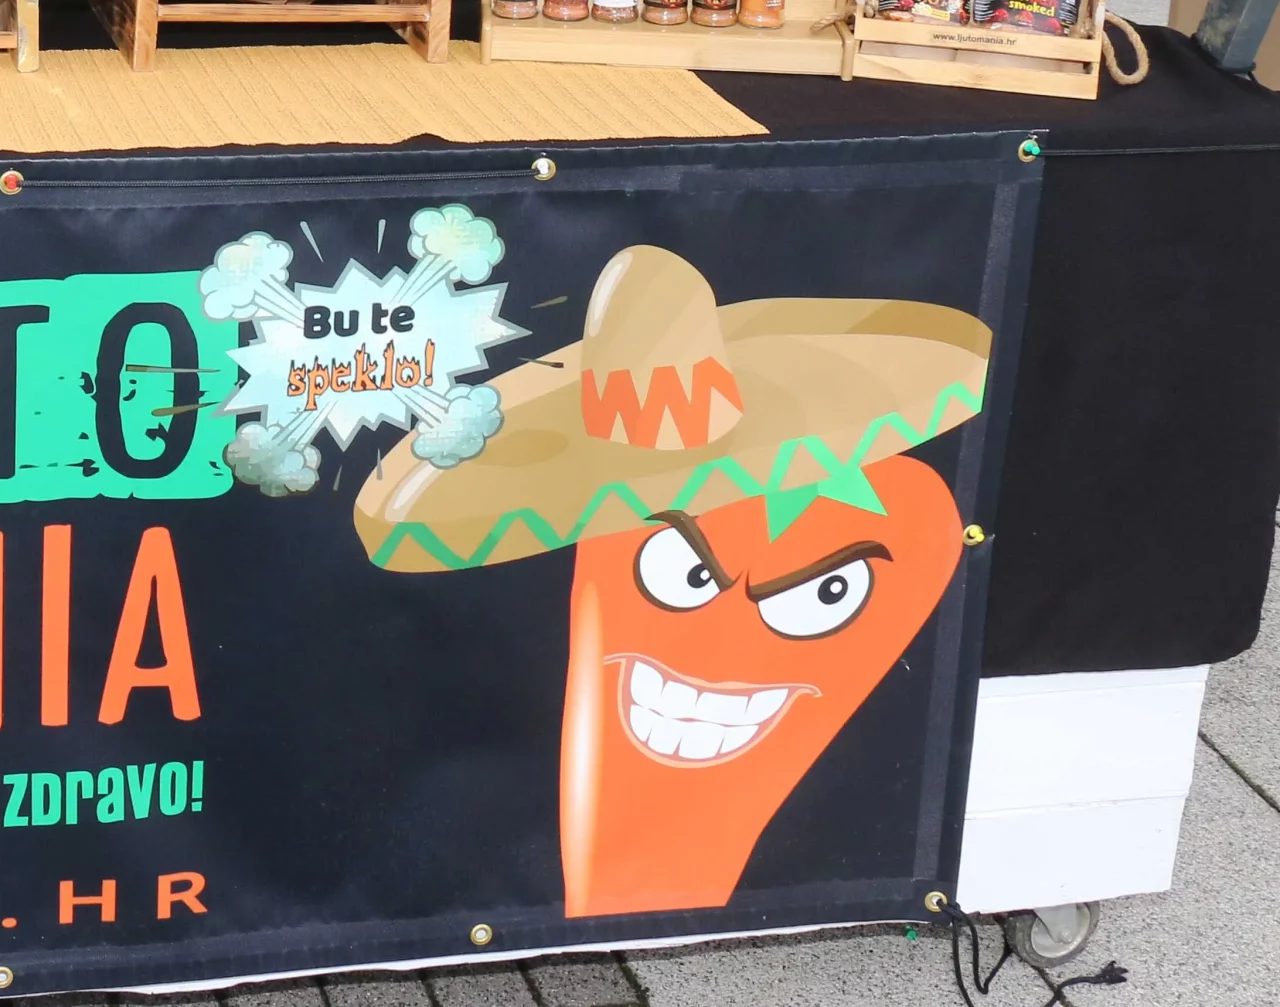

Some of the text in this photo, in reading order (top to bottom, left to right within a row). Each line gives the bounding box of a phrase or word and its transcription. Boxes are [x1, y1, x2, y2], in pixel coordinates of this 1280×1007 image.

[1009, 0, 1055, 16] smoked
[933, 32, 1016, 46] www.ljutomania.hr
[303, 303, 416, 340] Bu te
[286, 338, 436, 410] speklo!
